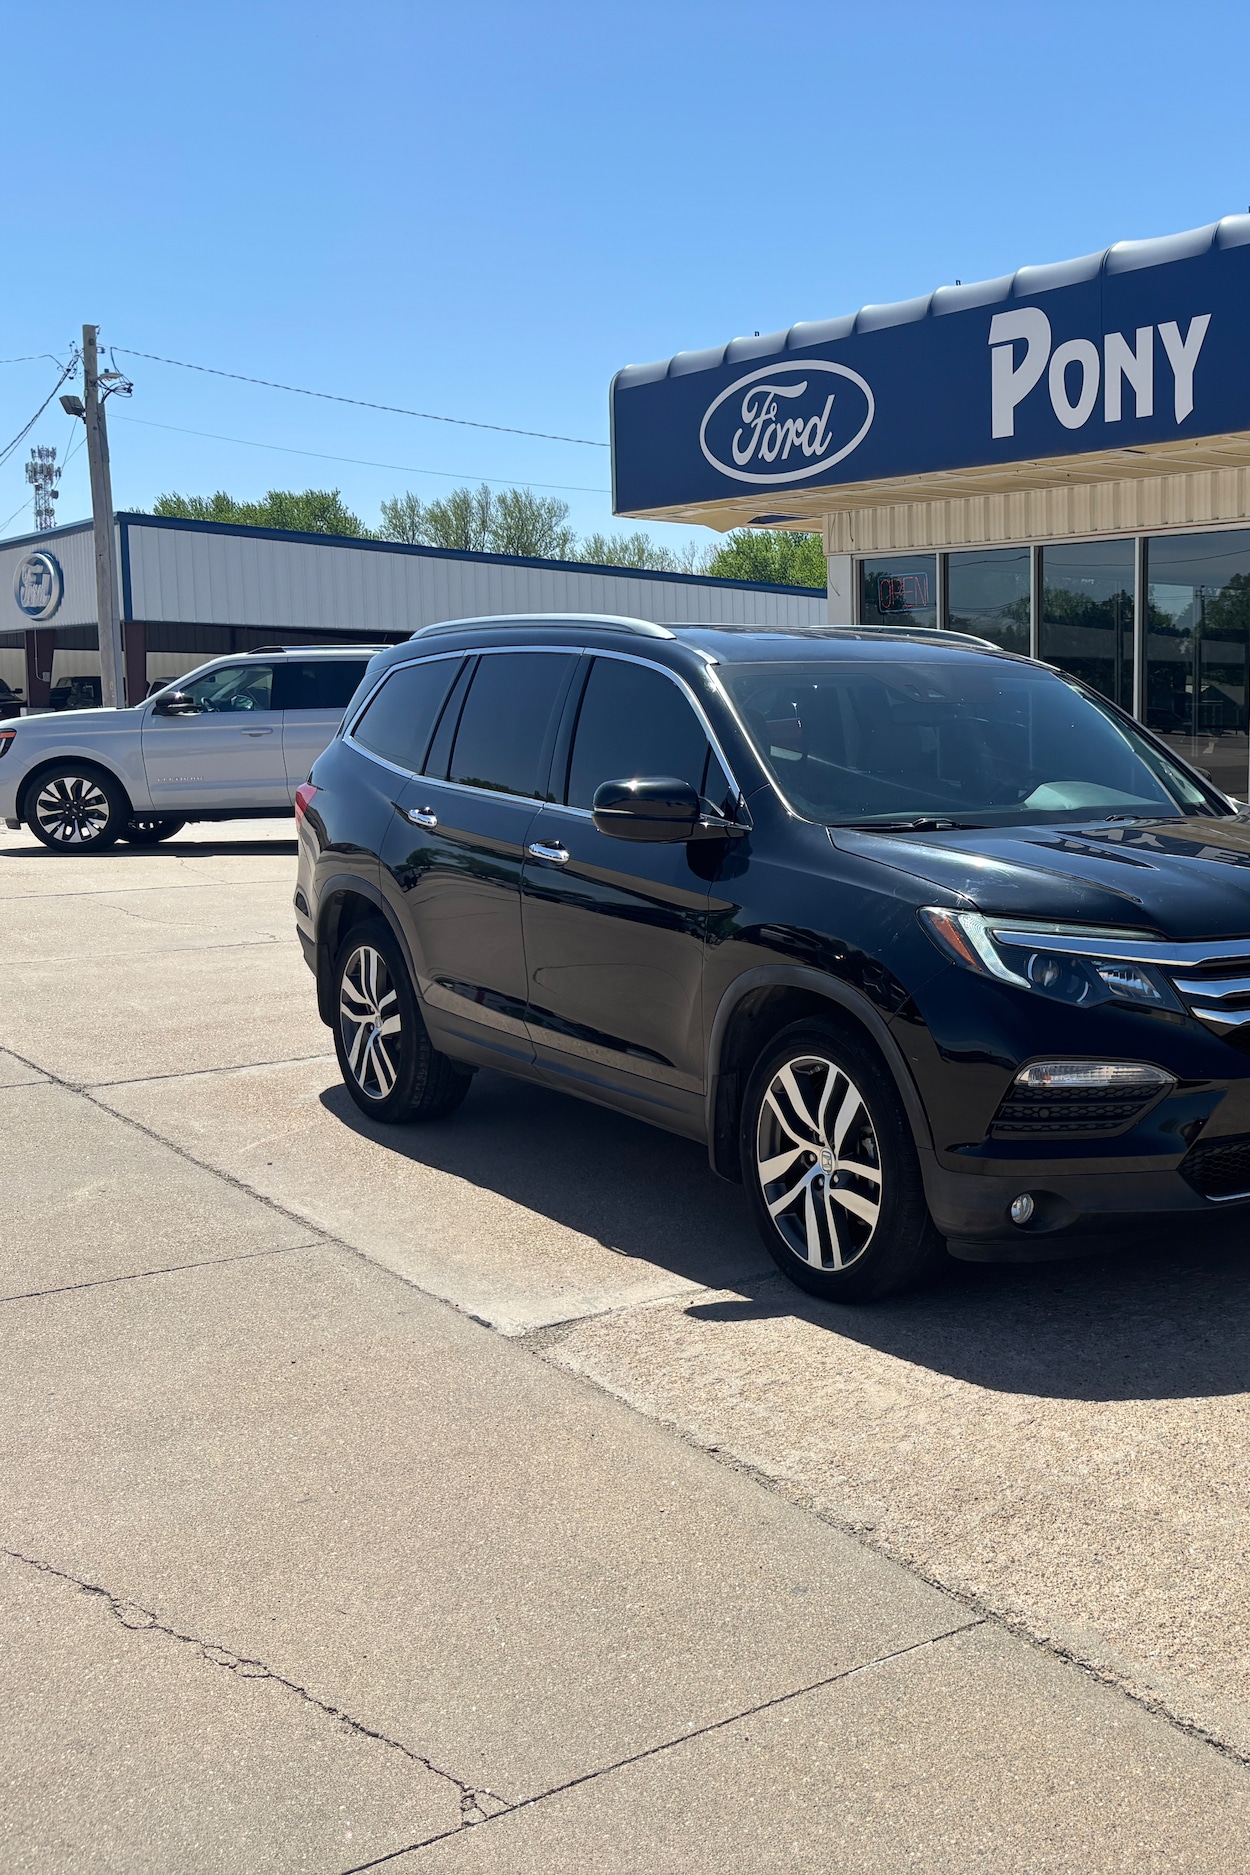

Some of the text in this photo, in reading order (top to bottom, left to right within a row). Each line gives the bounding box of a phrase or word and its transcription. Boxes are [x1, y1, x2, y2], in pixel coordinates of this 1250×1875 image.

[988, 307, 1212, 439] PONY
[731, 380, 836, 466] Ford
[880, 576, 926, 608] OPEN
